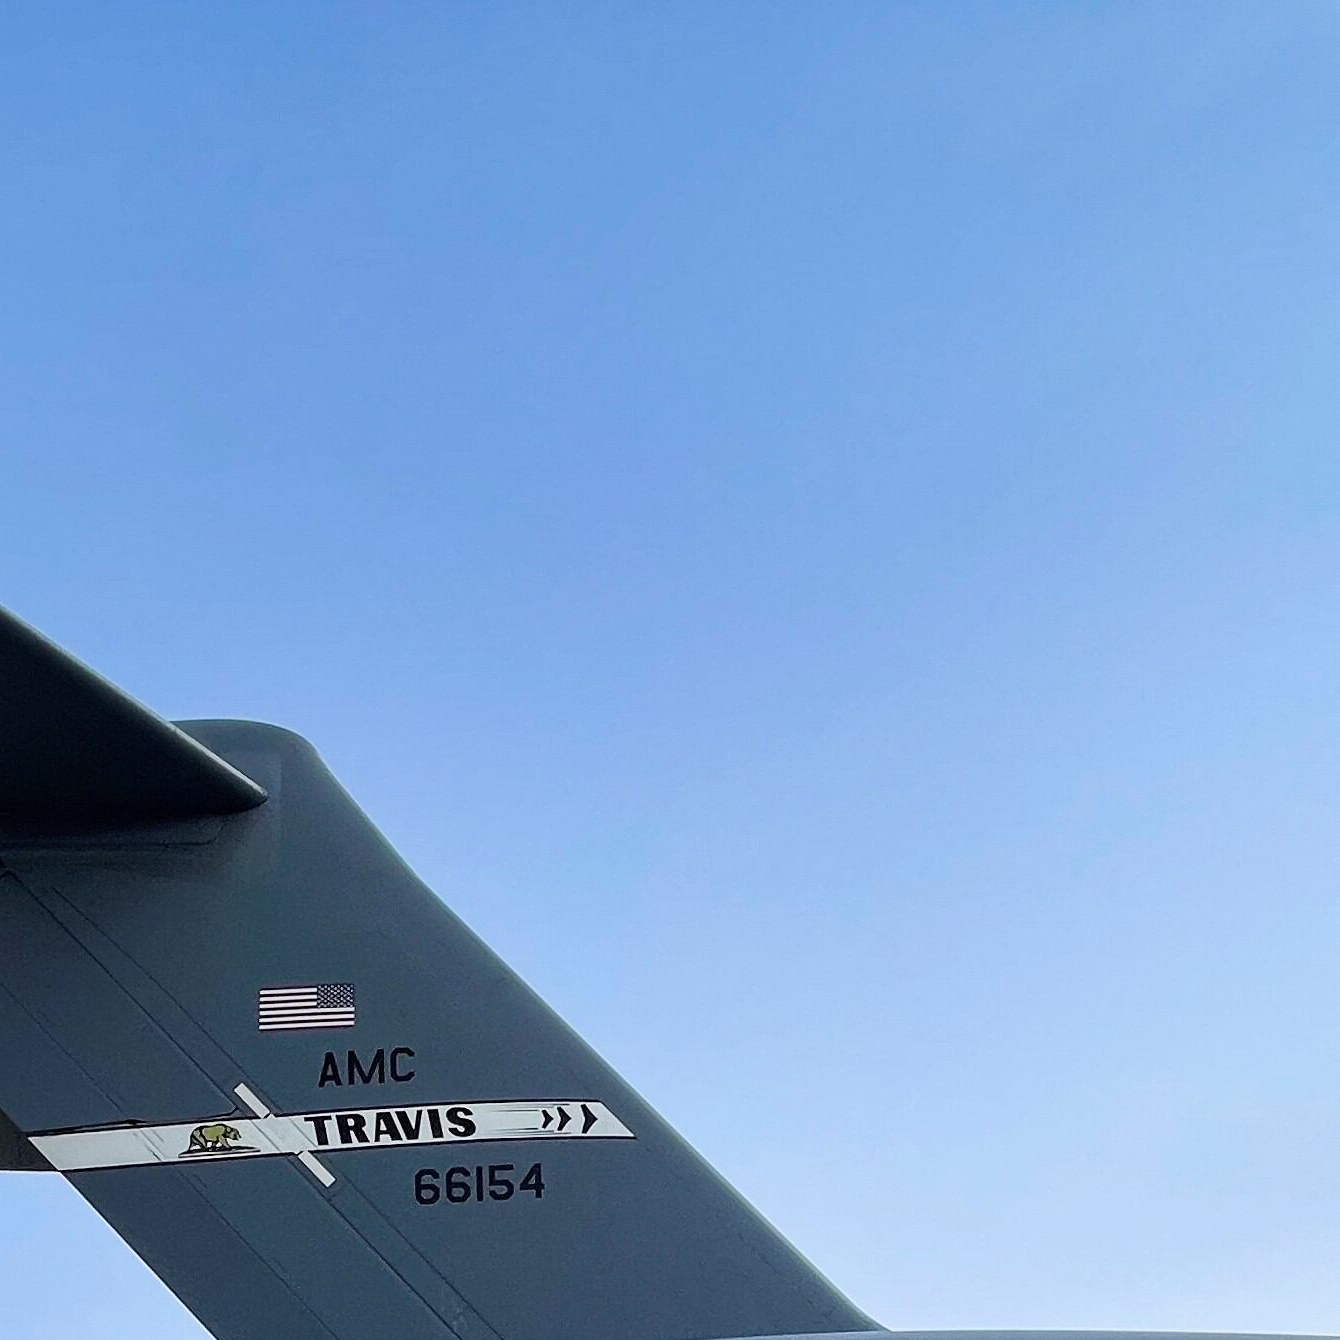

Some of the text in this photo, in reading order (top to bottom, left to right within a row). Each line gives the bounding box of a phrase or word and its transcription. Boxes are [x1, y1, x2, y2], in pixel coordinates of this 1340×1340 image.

[318, 1047, 416, 1088] AMC
[304, 1107, 476, 1146] TRAVIS
[414, 1163, 545, 1205] 66154
